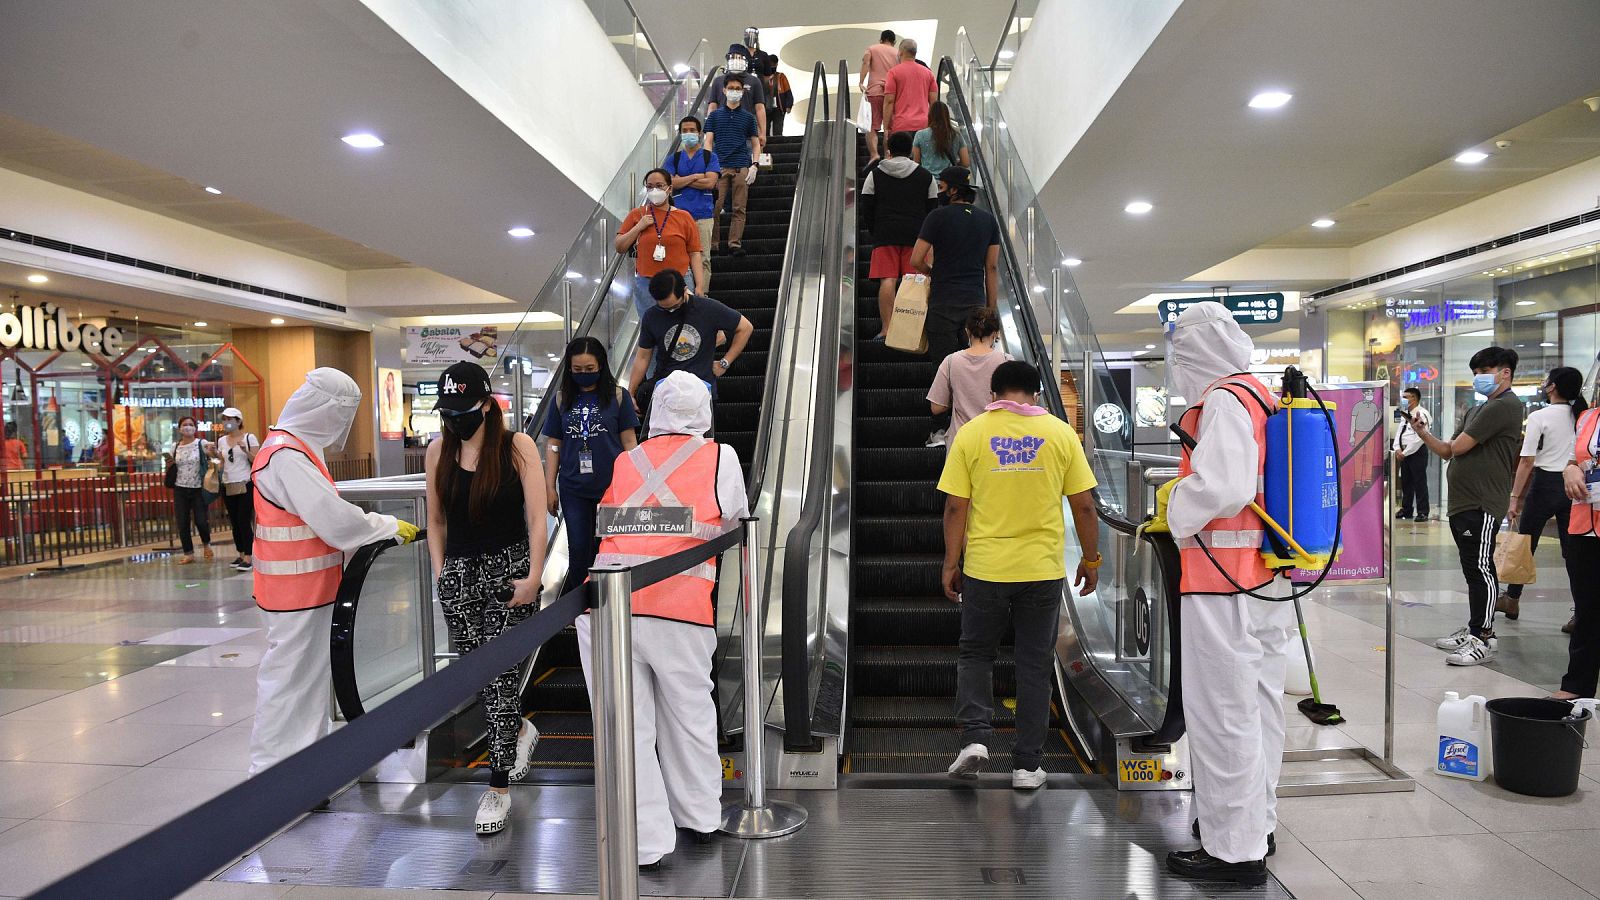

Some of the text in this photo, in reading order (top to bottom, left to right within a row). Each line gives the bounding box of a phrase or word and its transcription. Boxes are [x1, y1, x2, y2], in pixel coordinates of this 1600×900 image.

[991, 436, 1045, 451] FURRY
[996, 450, 1036, 465] TAILS
[606, 524, 684, 533] SANITATION TEAM
[1127, 771, 1154, 781] 1000
